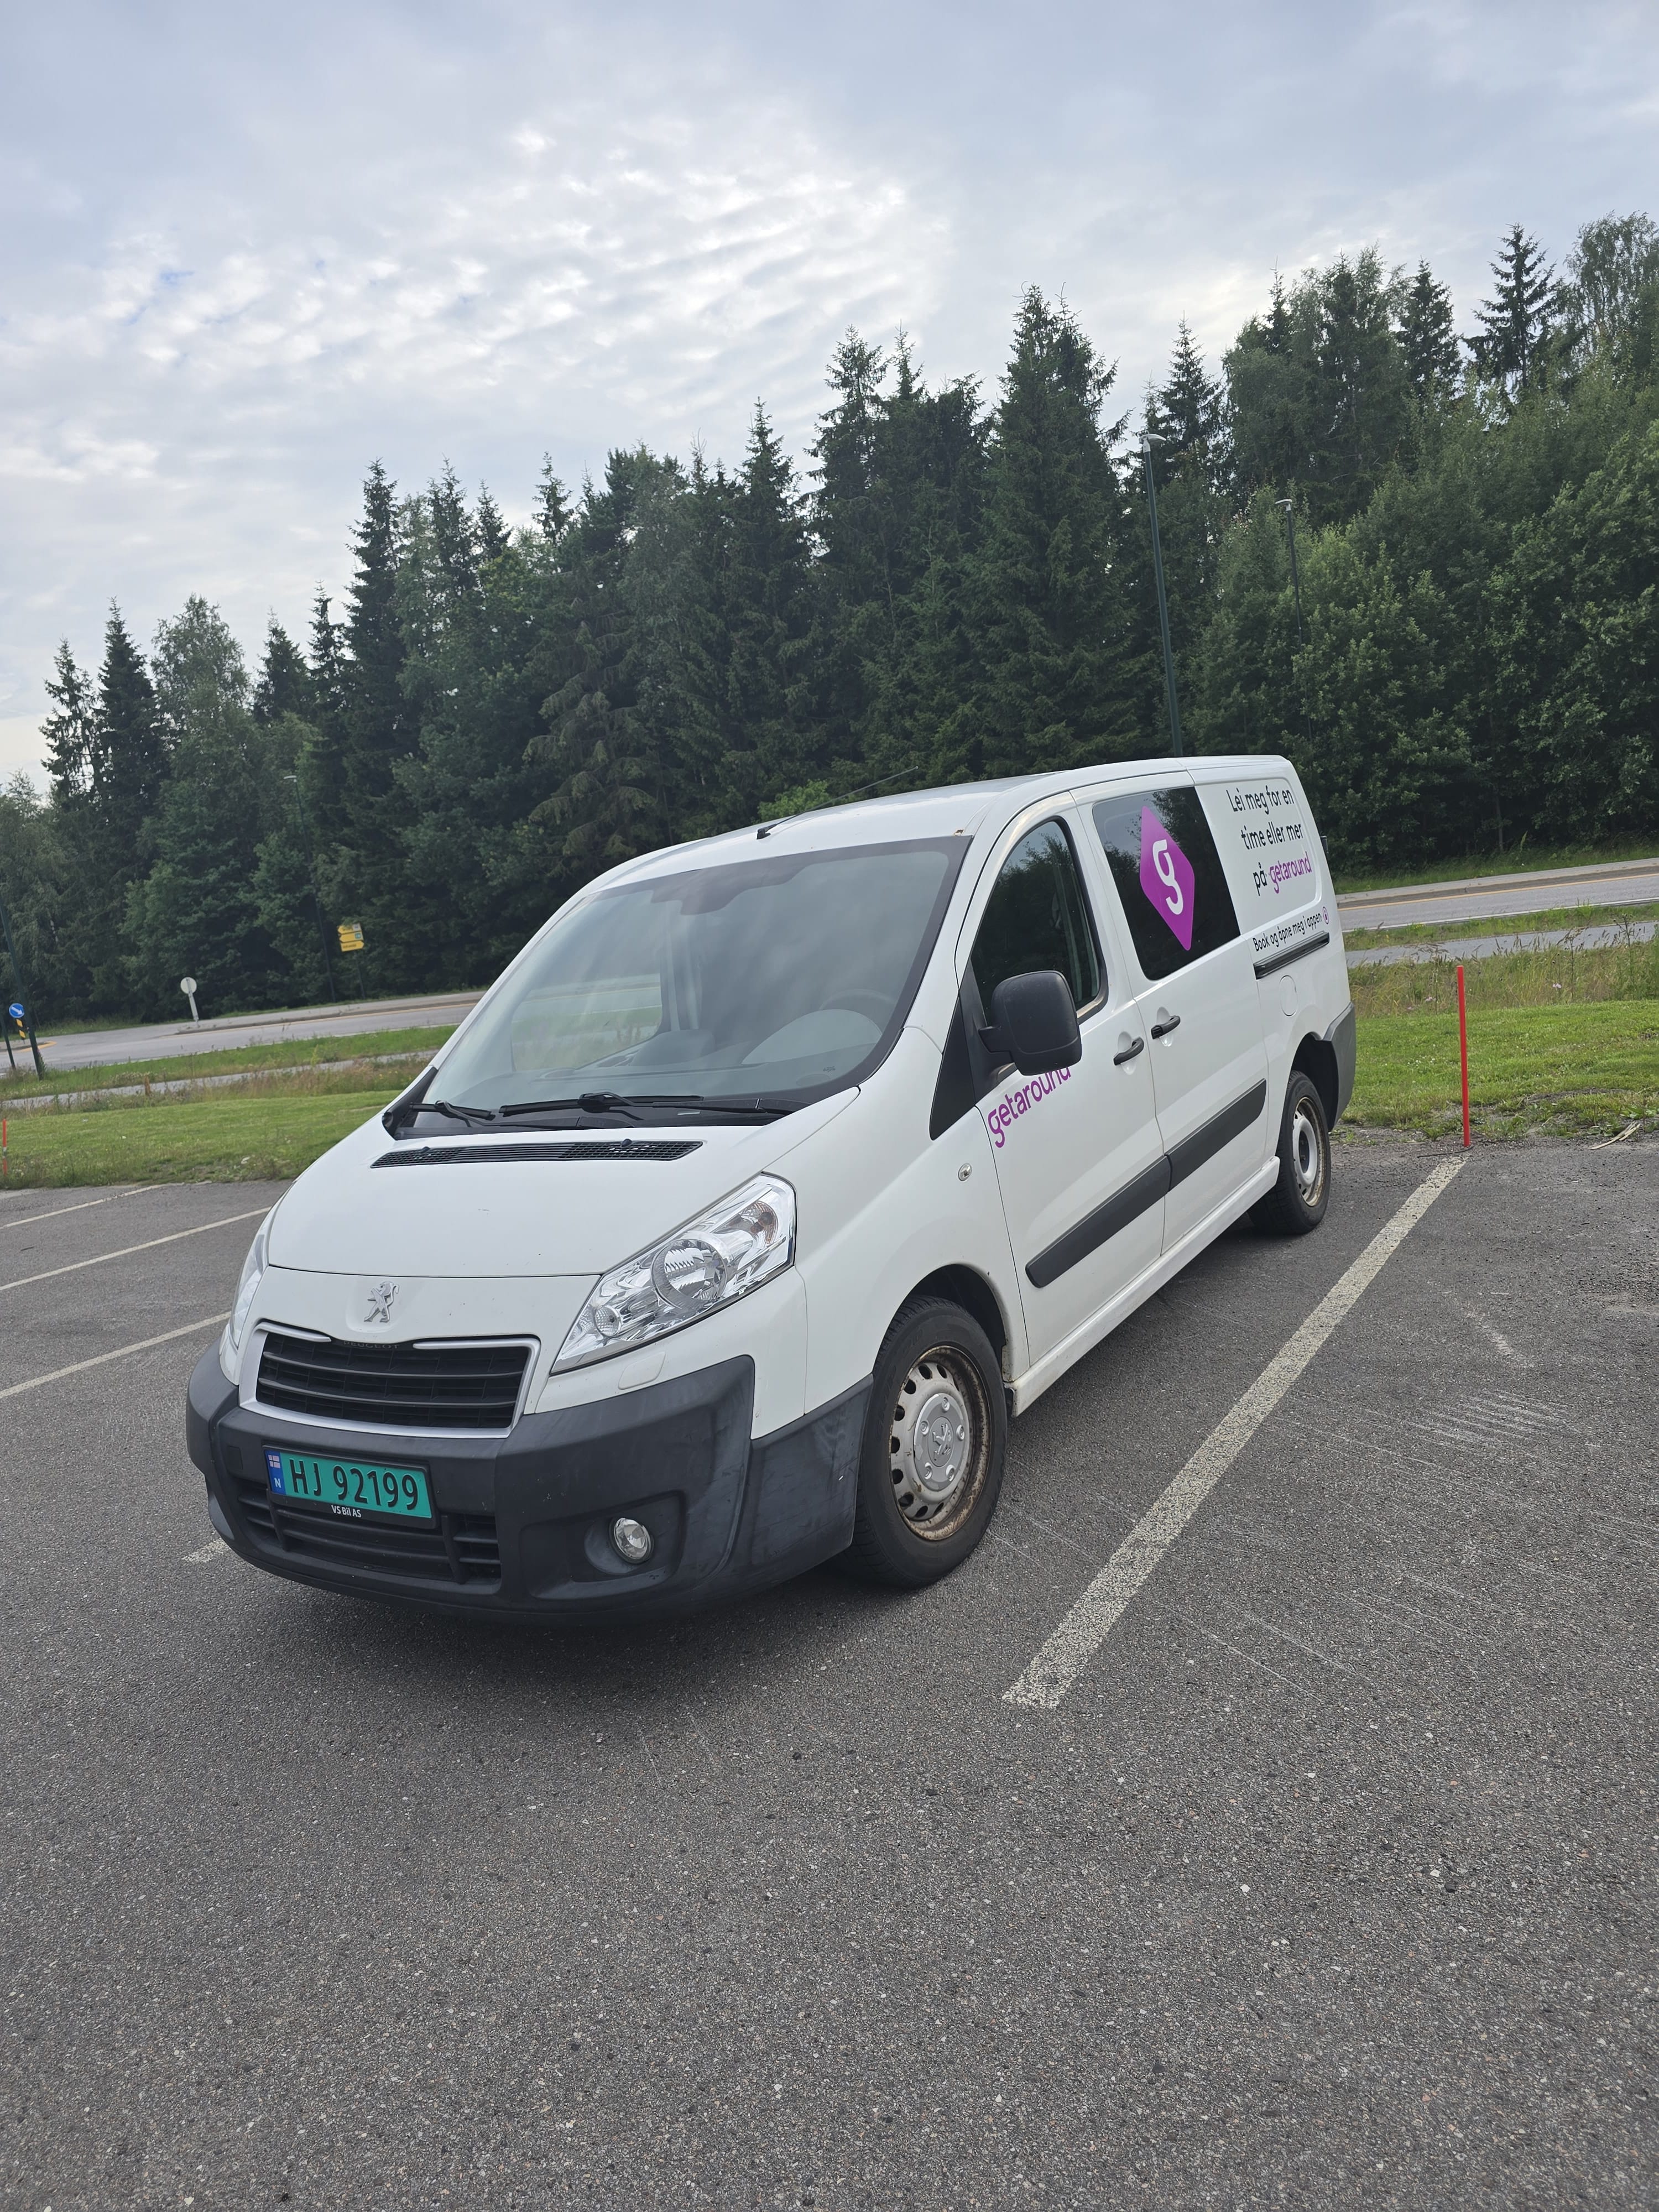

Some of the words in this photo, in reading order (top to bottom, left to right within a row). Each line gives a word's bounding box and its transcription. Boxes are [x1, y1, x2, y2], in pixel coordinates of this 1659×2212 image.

[1226, 787, 1246, 812] Lei
[1245, 792, 1269, 815] meg
[1265, 785, 1282, 807] for
[1282, 789, 1295, 805] en
[1241, 825, 1266, 849] time
[1266, 822, 1286, 844] eller
[1286, 823, 1303, 841] mer
[1253, 862, 1268, 896] på
[1270, 851, 1312, 894] getaround
[1253, 933, 1270, 952] Book
[1270, 933, 1279, 947] og
[1277, 926, 1292, 944] åpne
[1292, 921, 1305, 935] meg
[1302, 915, 1307, 928] i
[1307, 913, 1322, 930] appen
[274, 1477, 281, 1488] N
[289, 1458, 322, 1496] HJ
[333, 1465, 419, 1511] 92199
[331, 1505, 341, 1514] VS
[341, 1506, 352, 1516] Bil
[352, 1508, 362, 1518] AS
